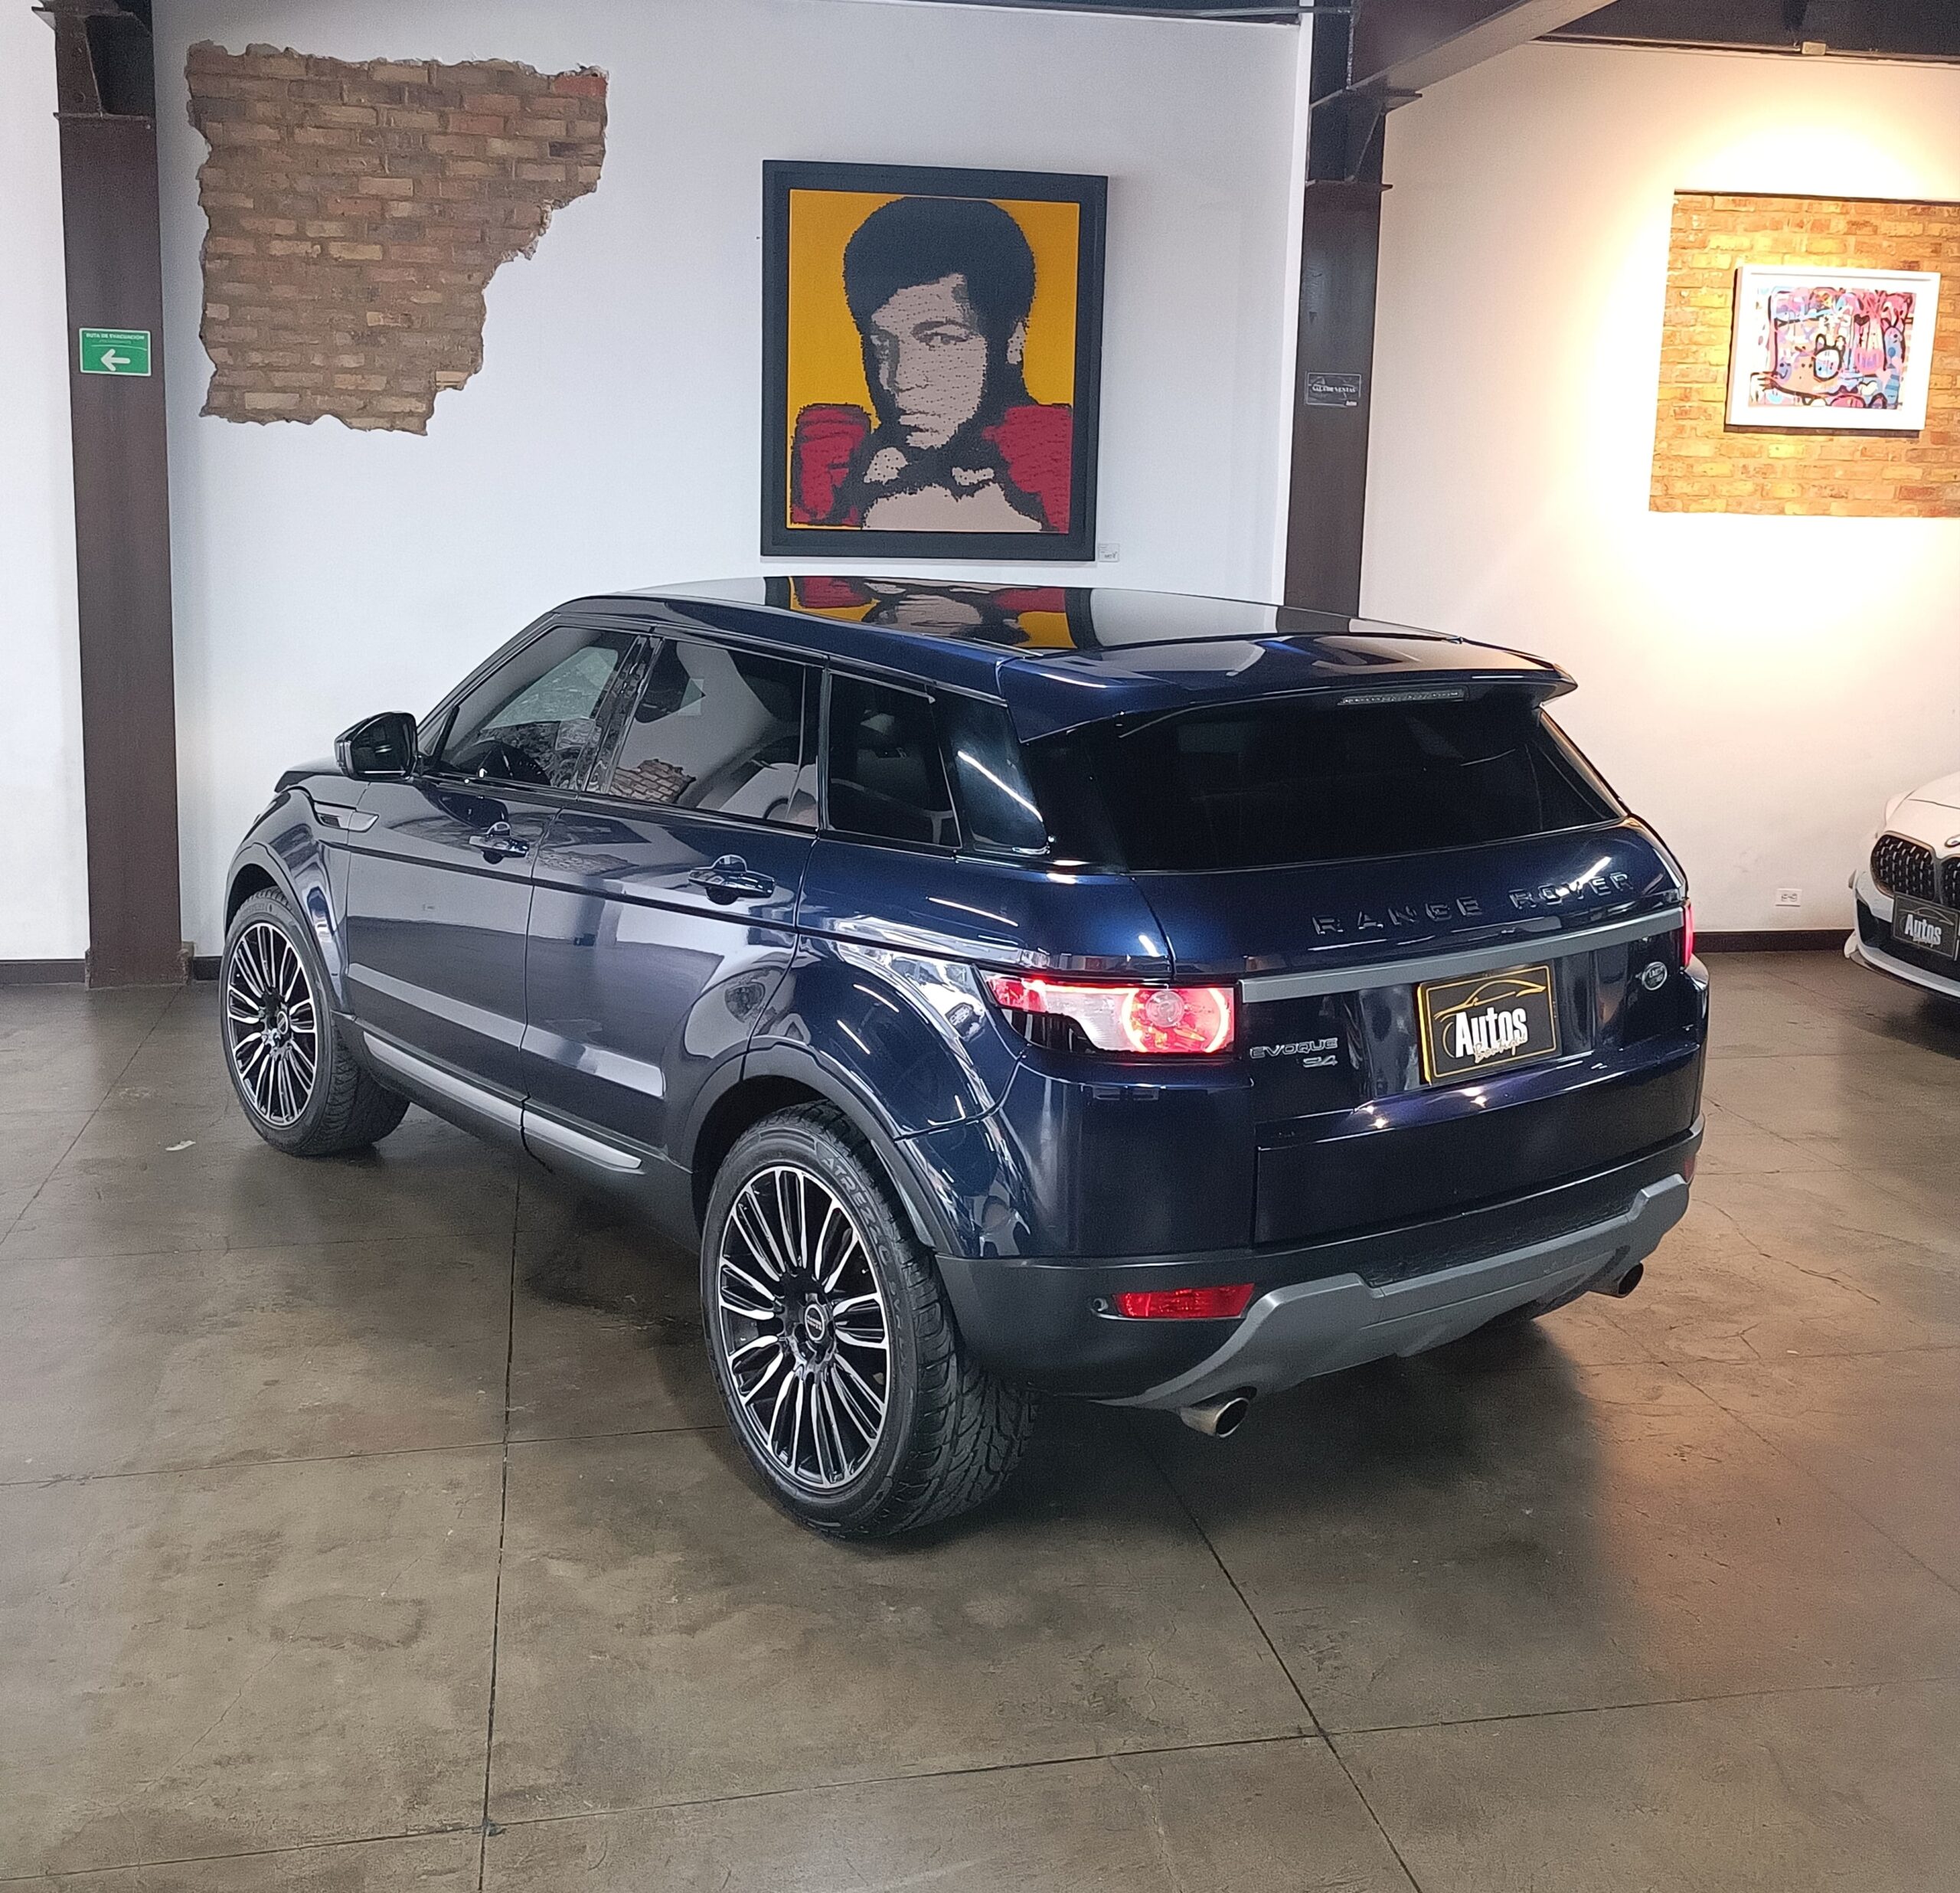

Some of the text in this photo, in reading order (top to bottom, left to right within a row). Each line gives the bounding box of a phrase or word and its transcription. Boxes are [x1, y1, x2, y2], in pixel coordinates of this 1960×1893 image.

[1312, 871, 1634, 935] RANGE ROVER
[1904, 914, 1942, 945] Autos
[1250, 1038, 1338, 1059] EVOQUE
[1455, 1007, 1528, 1058] Autos
